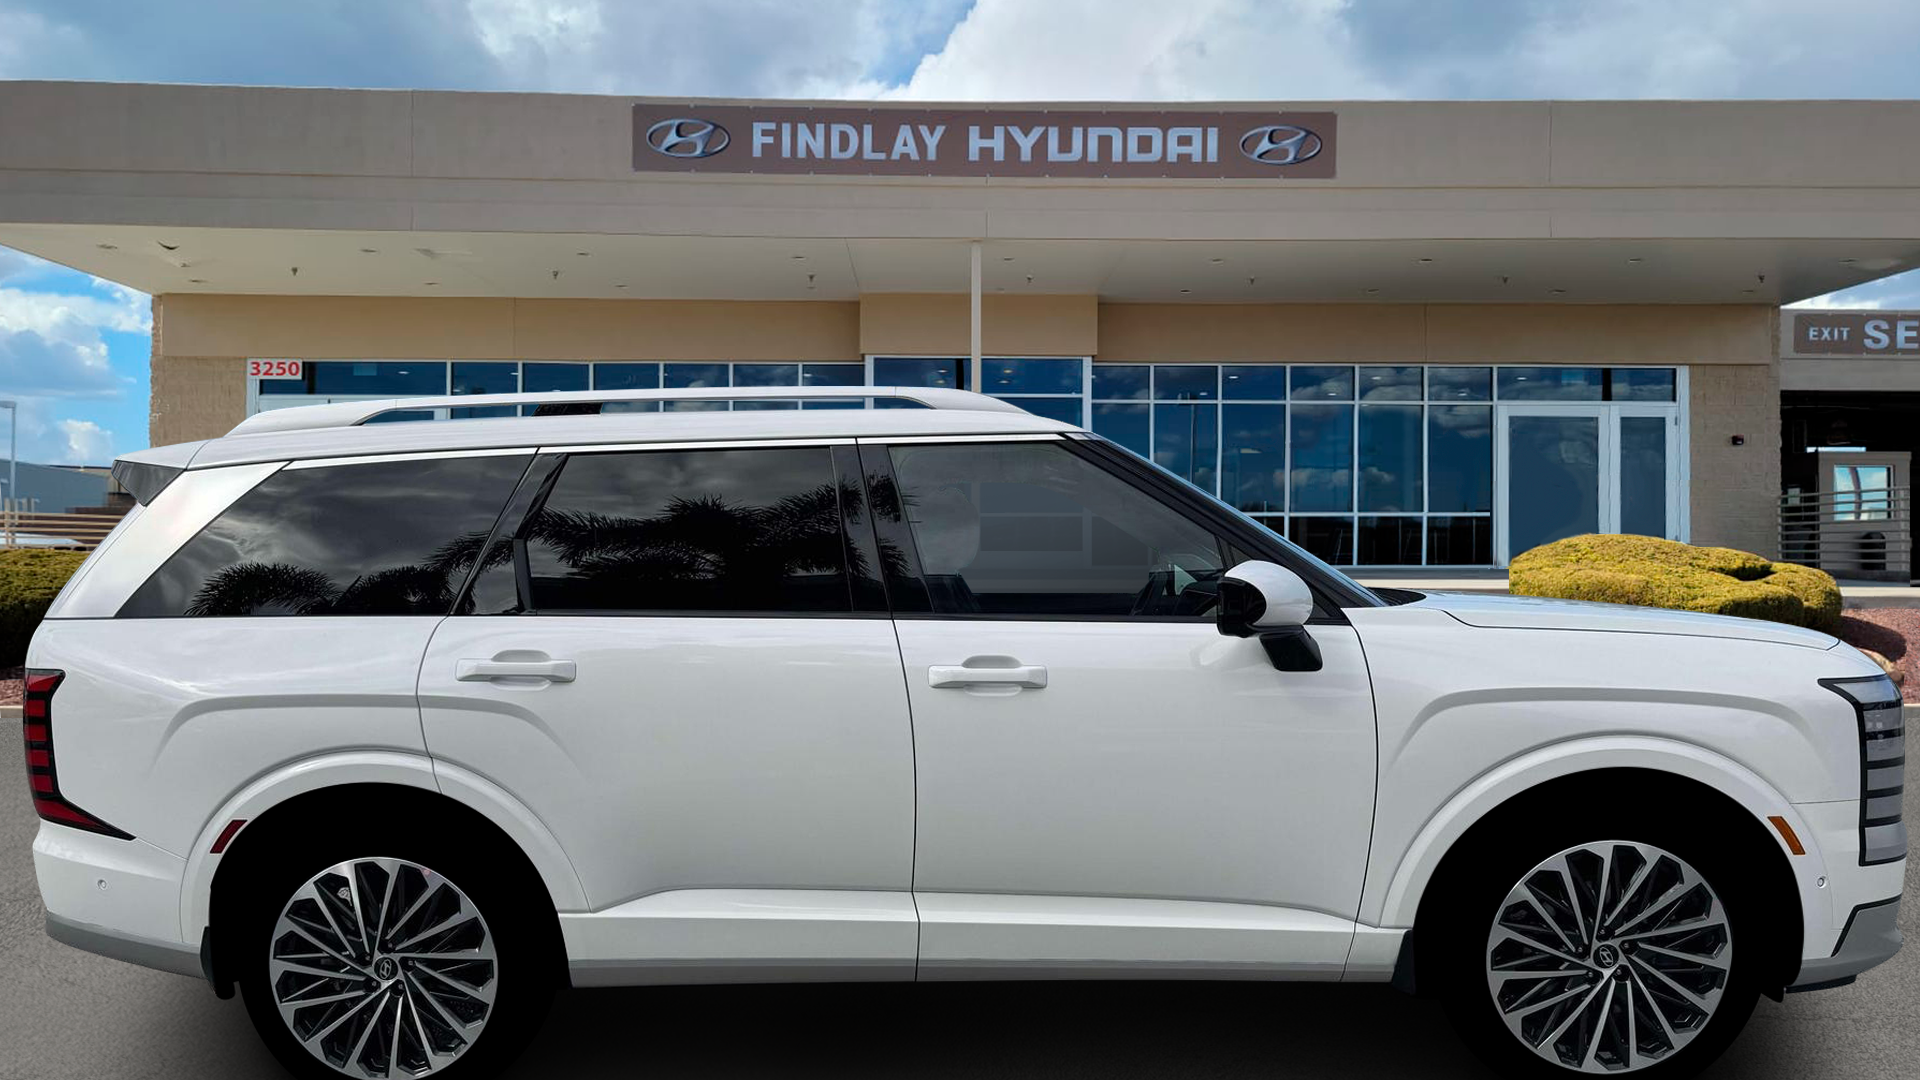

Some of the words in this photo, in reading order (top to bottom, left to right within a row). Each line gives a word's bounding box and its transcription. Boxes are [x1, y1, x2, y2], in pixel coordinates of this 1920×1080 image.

[752, 121, 946, 161] FINDLAY
[968, 125, 1218, 163] HYUNDAI
[1809, 327, 1851, 341] EXIT
[1863, 319, 1919, 350] SE
[249, 361, 300, 376] 3250
